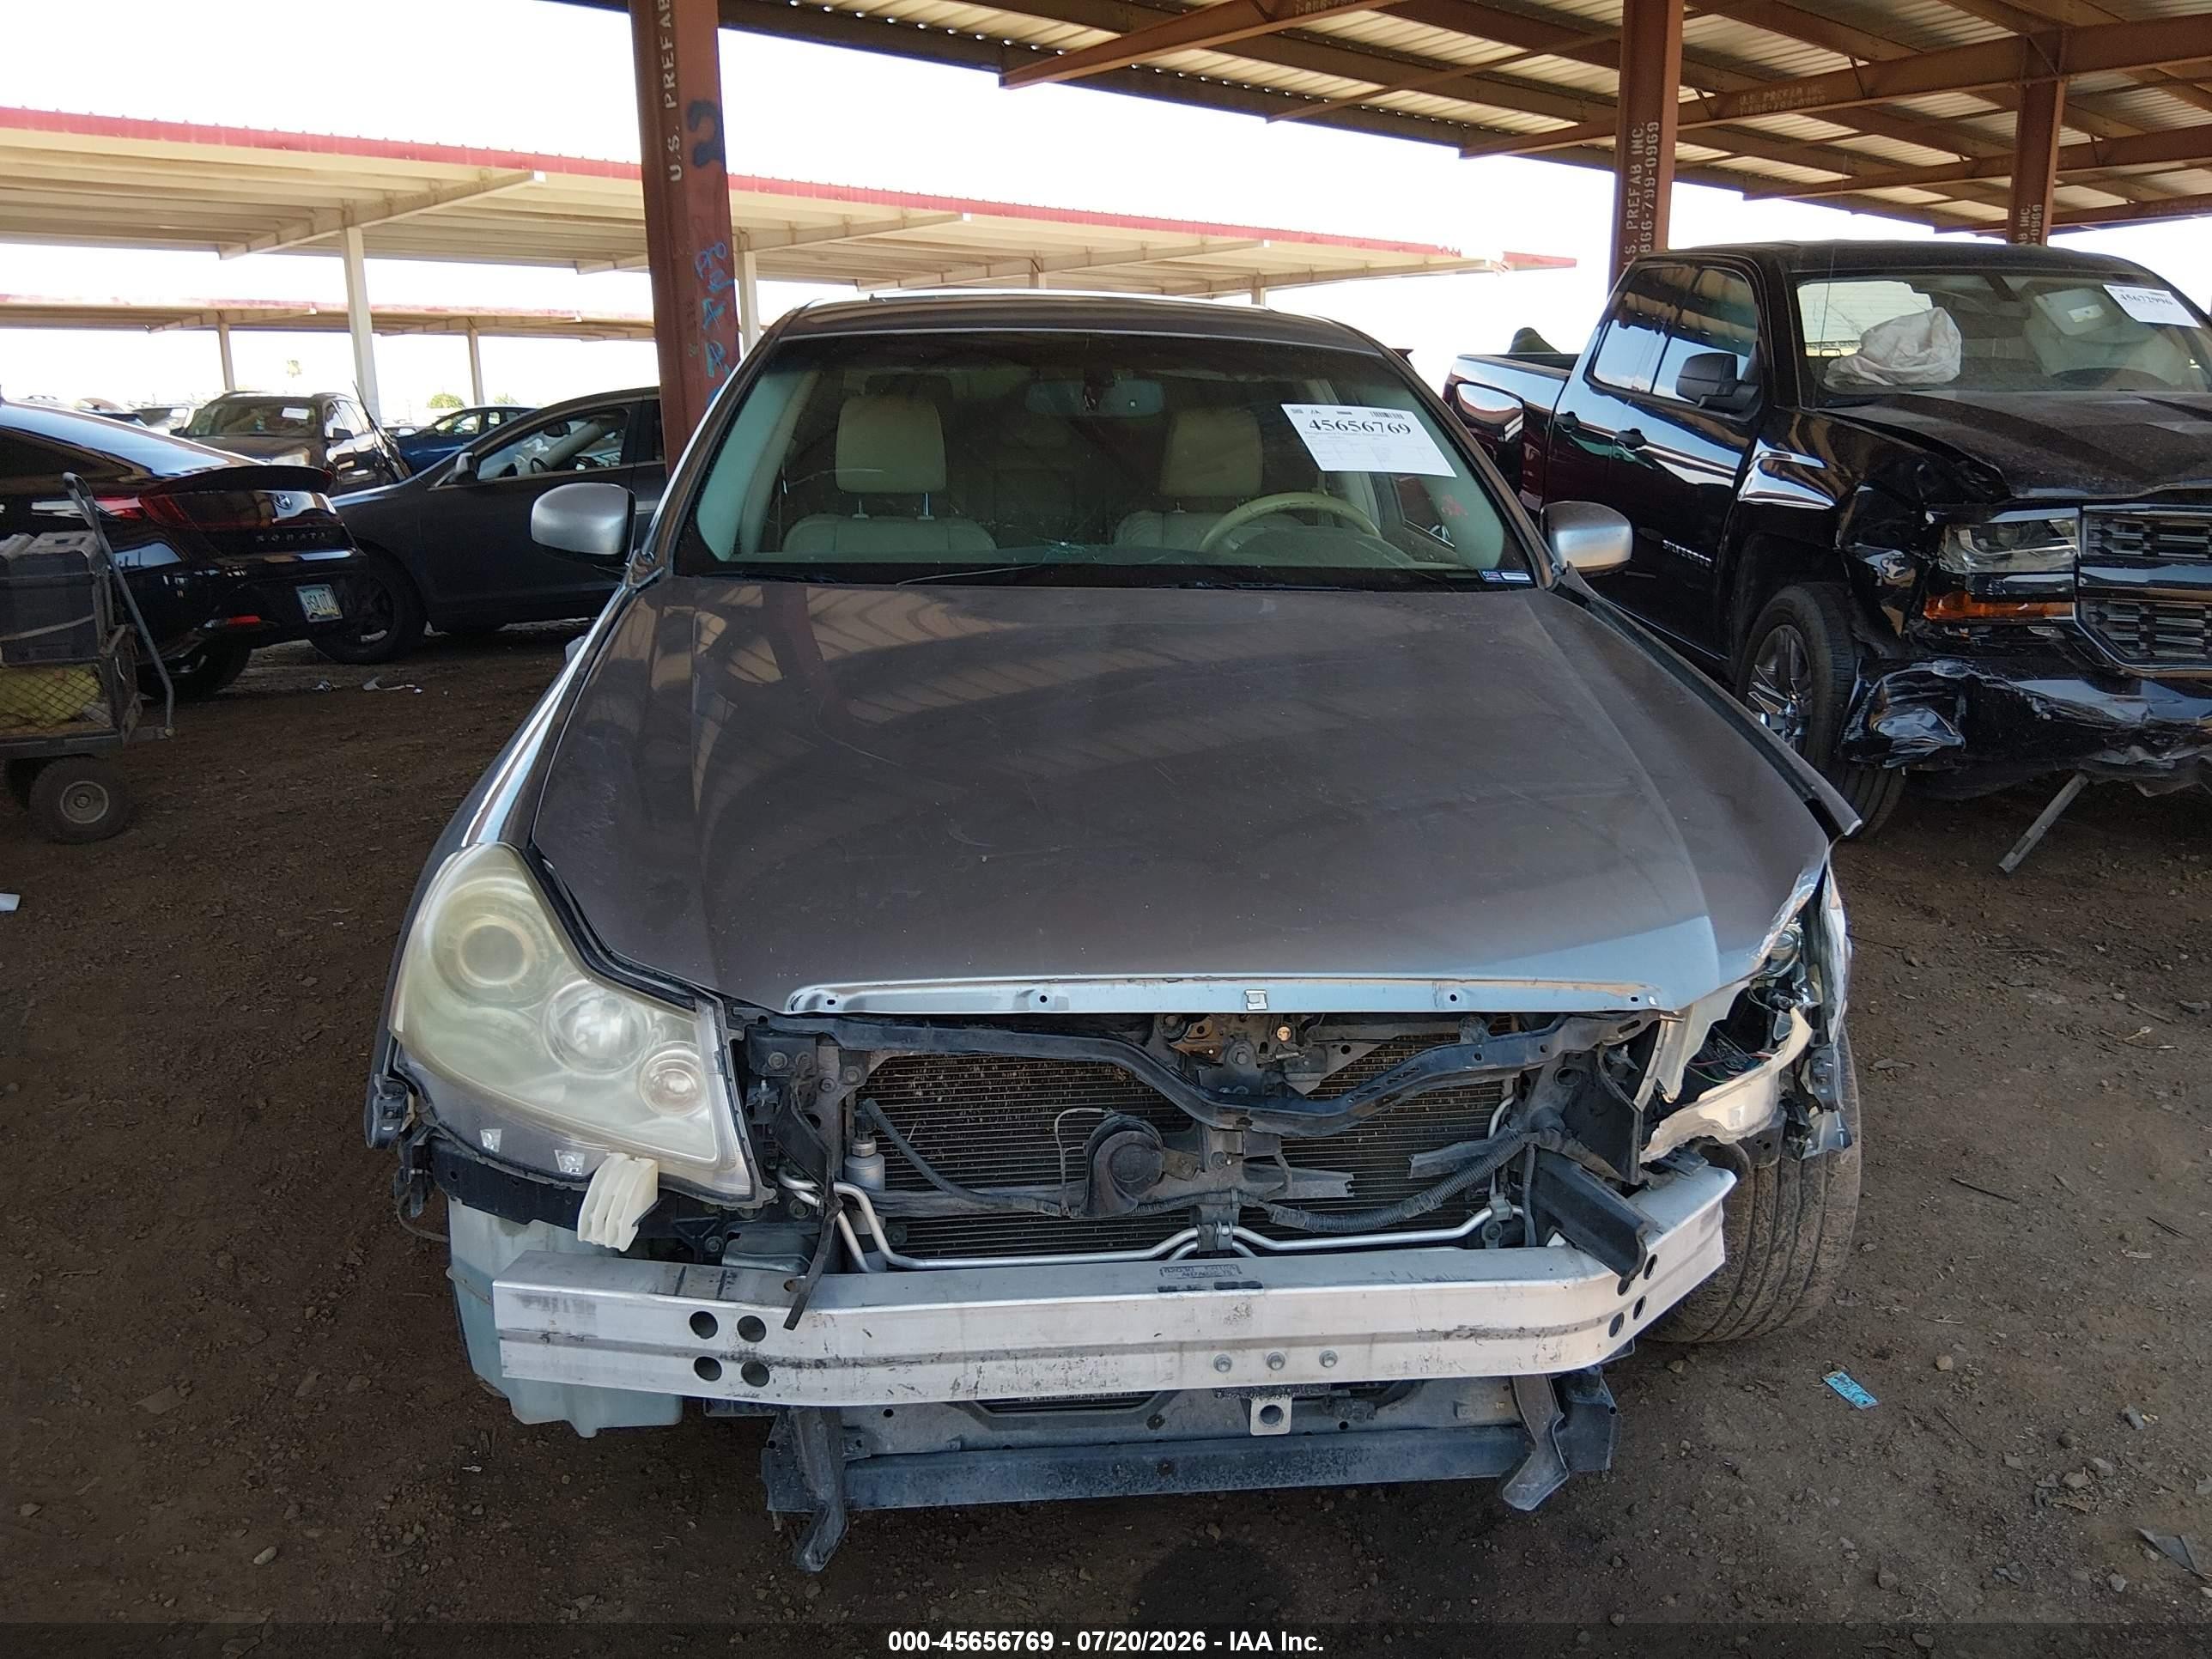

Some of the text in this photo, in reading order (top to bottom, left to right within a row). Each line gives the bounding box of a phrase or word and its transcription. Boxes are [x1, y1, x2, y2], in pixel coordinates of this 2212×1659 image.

[666, 126, 684, 182] U.S.
[1632, 122, 1644, 155] INC.
[1626, 163, 1643, 230] PREFAB
[1309, 419, 1412, 434] 45656769
